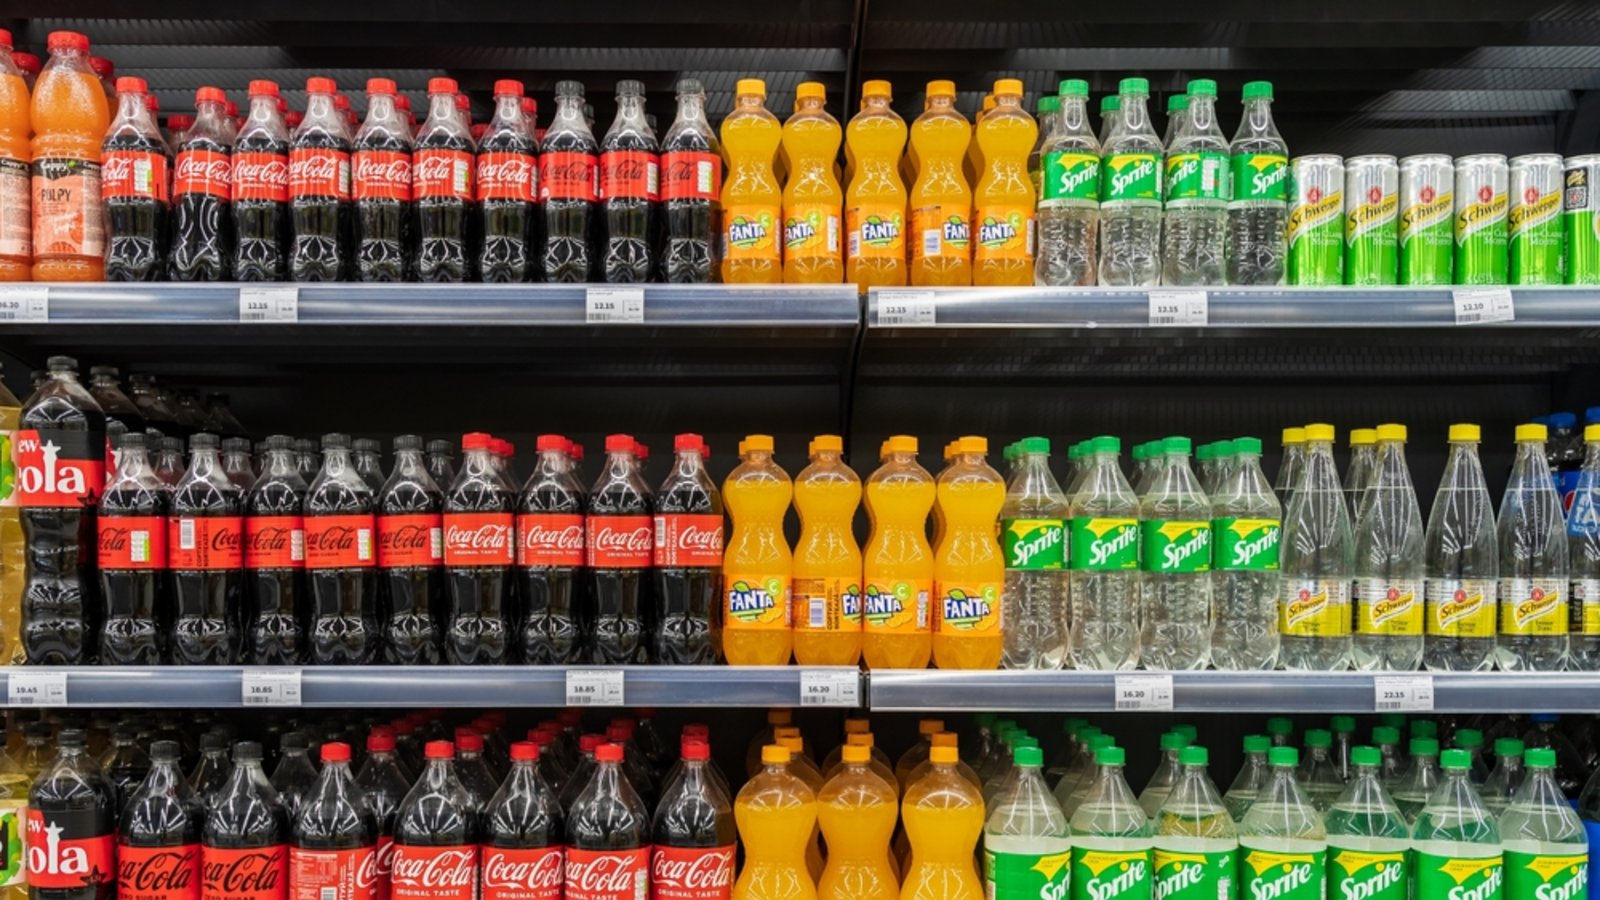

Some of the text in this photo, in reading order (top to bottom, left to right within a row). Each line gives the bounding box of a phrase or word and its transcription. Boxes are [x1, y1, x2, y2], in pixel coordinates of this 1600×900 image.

[1110, 160, 1154, 196] Sprite
[41, 188, 71, 202] PULPY
[729, 222, 766, 242] FANTA
[861, 222, 899, 241] FANTA
[979, 225, 1016, 241] FANTA
[0, 301, 19, 309] 6.20
[594, 302, 615, 310] 12.15
[18, 439, 41, 453] ew
[18, 440, 86, 494] ola
[447, 524, 508, 549] Coca-Cola
[1012, 527, 1062, 566] Sprite
[1089, 526, 1137, 565] Sprite
[1162, 529, 1208, 568] Sprite
[1232, 528, 1279, 566] Sprite
[729, 590, 774, 612] FANTA
[943, 598, 990, 618] FANTA
[1123, 690, 1145, 698] 16.20
[28, 821, 89, 875] ola
[391, 849, 476, 887] Coca-Cola
[652, 850, 732, 889] Coca-Cola
[1087, 860, 1147, 900] Sprite
[1157, 863, 1206, 900] prite
[1250, 863, 1313, 900] Sprite
[1340, 861, 1402, 900] Sprite
[396, 888, 431, 897] ORIGINAL
[658, 888, 693, 898] ORIGINAL
